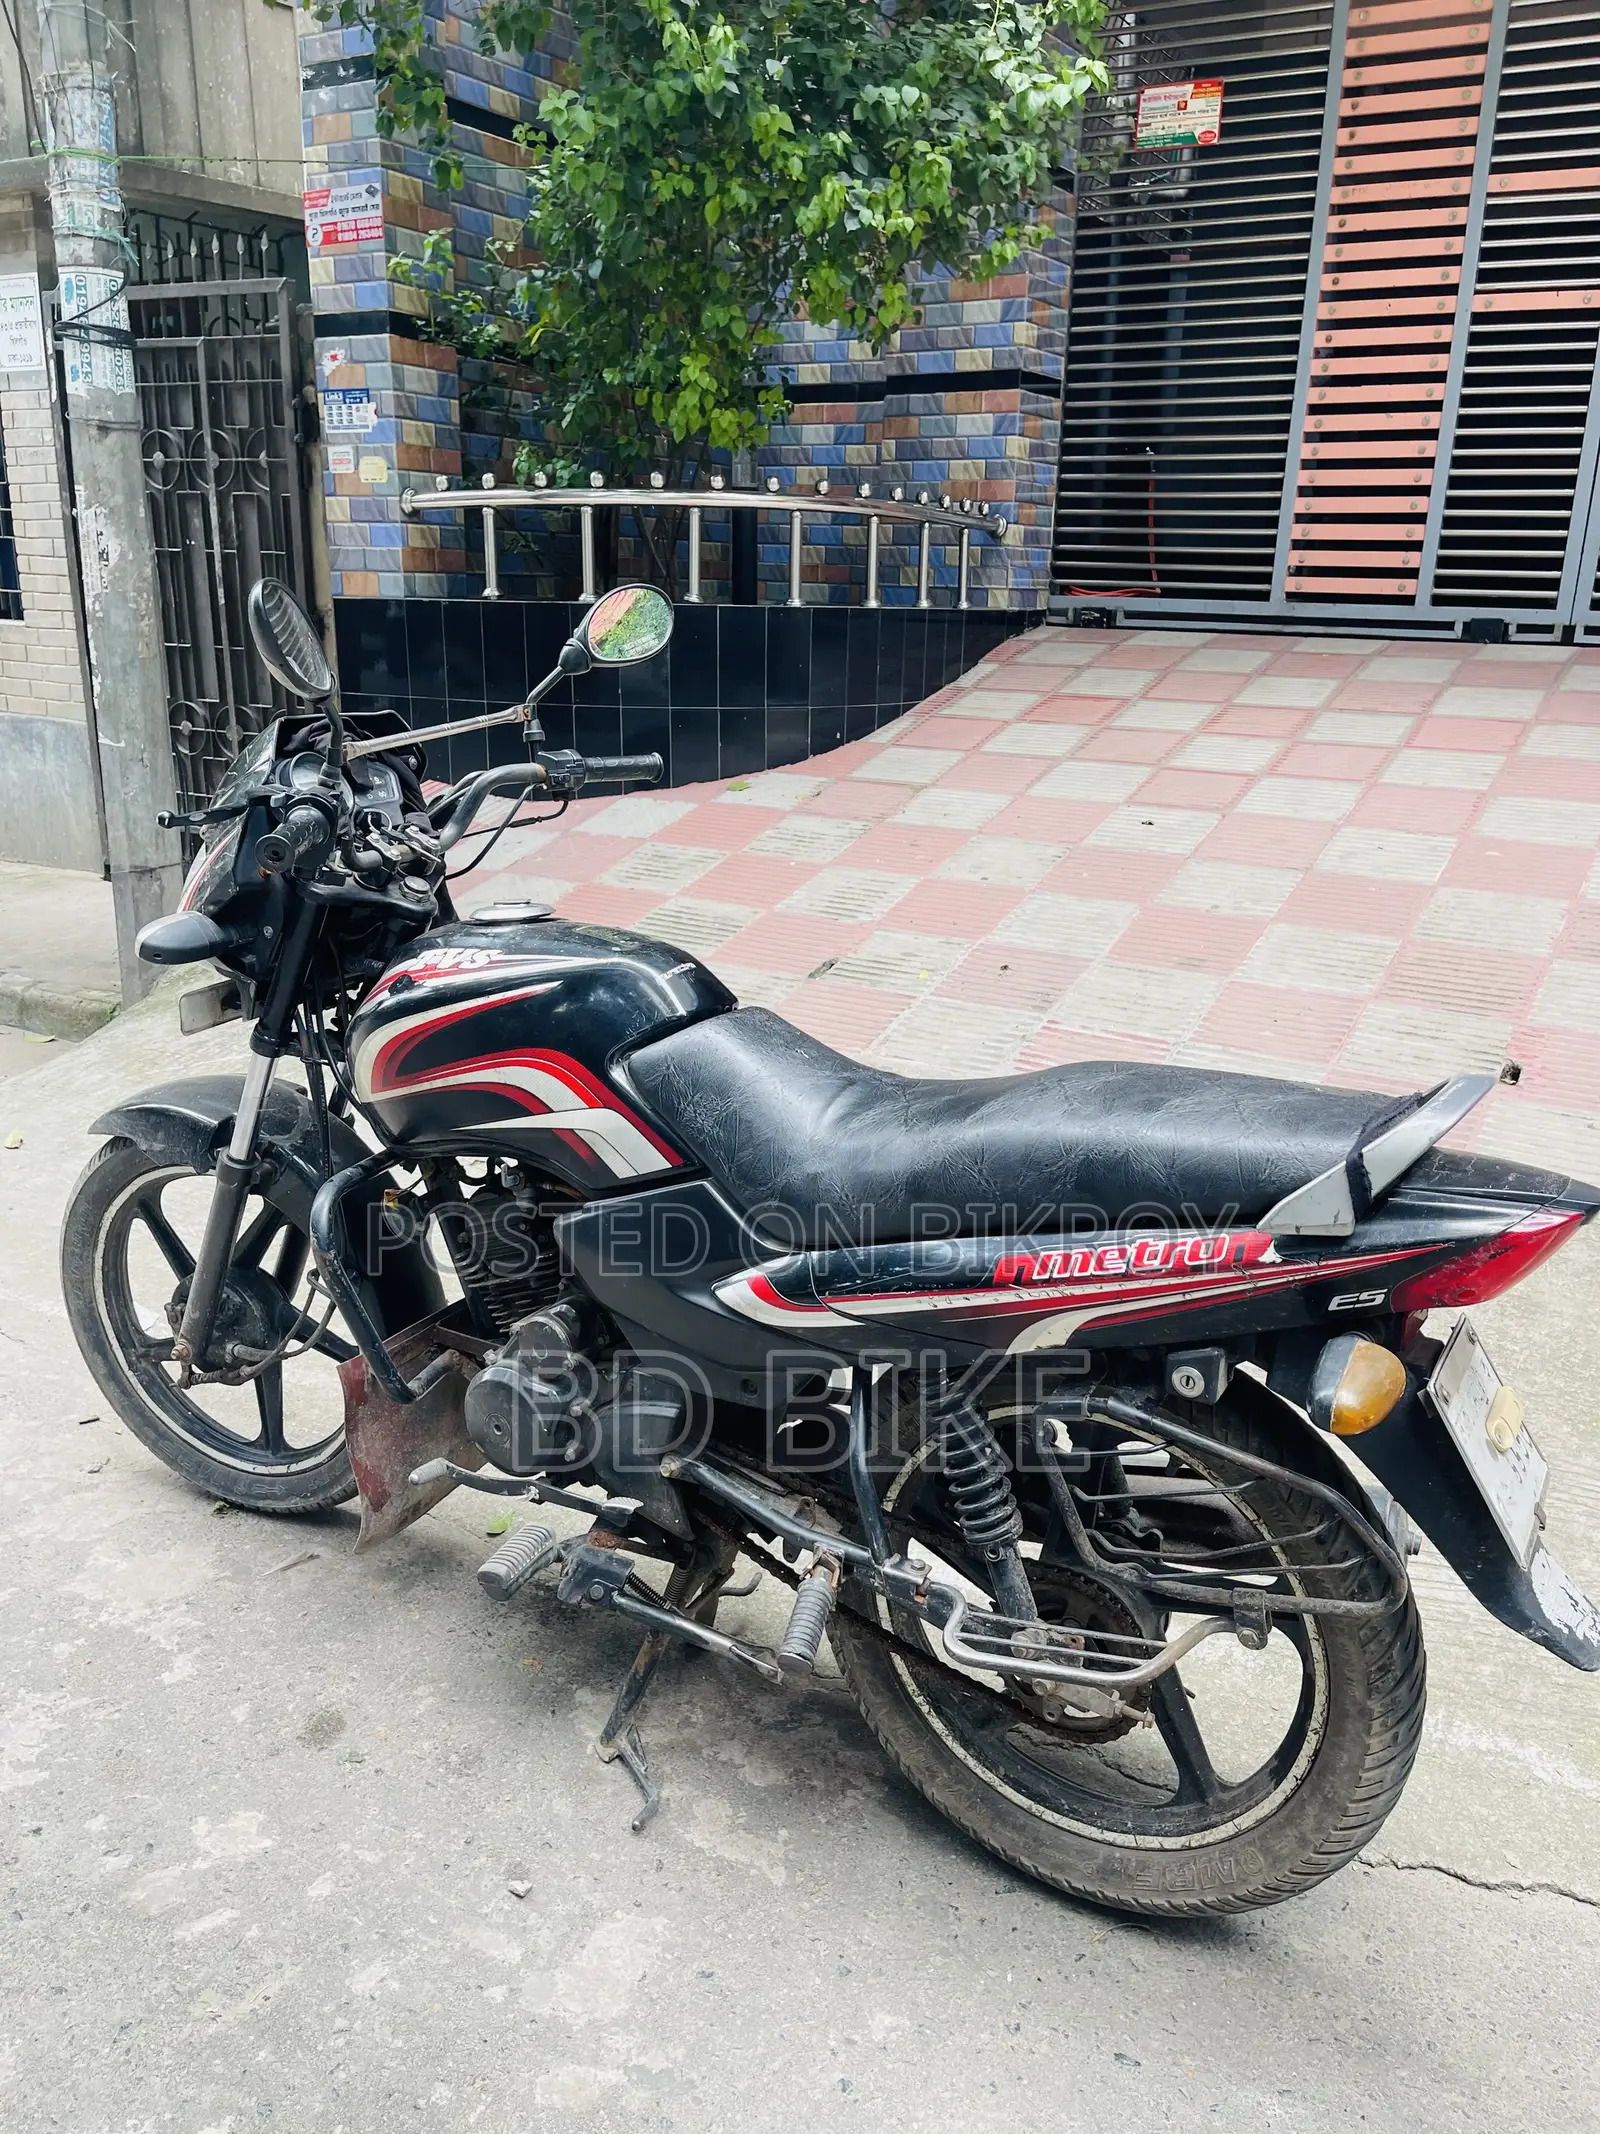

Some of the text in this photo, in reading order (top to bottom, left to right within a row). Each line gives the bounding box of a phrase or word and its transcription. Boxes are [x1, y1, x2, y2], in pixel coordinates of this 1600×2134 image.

[407, 947, 504, 971] TVS
[1031, 1233, 1230, 1280] metro
[1327, 1288, 1388, 1311] ES
